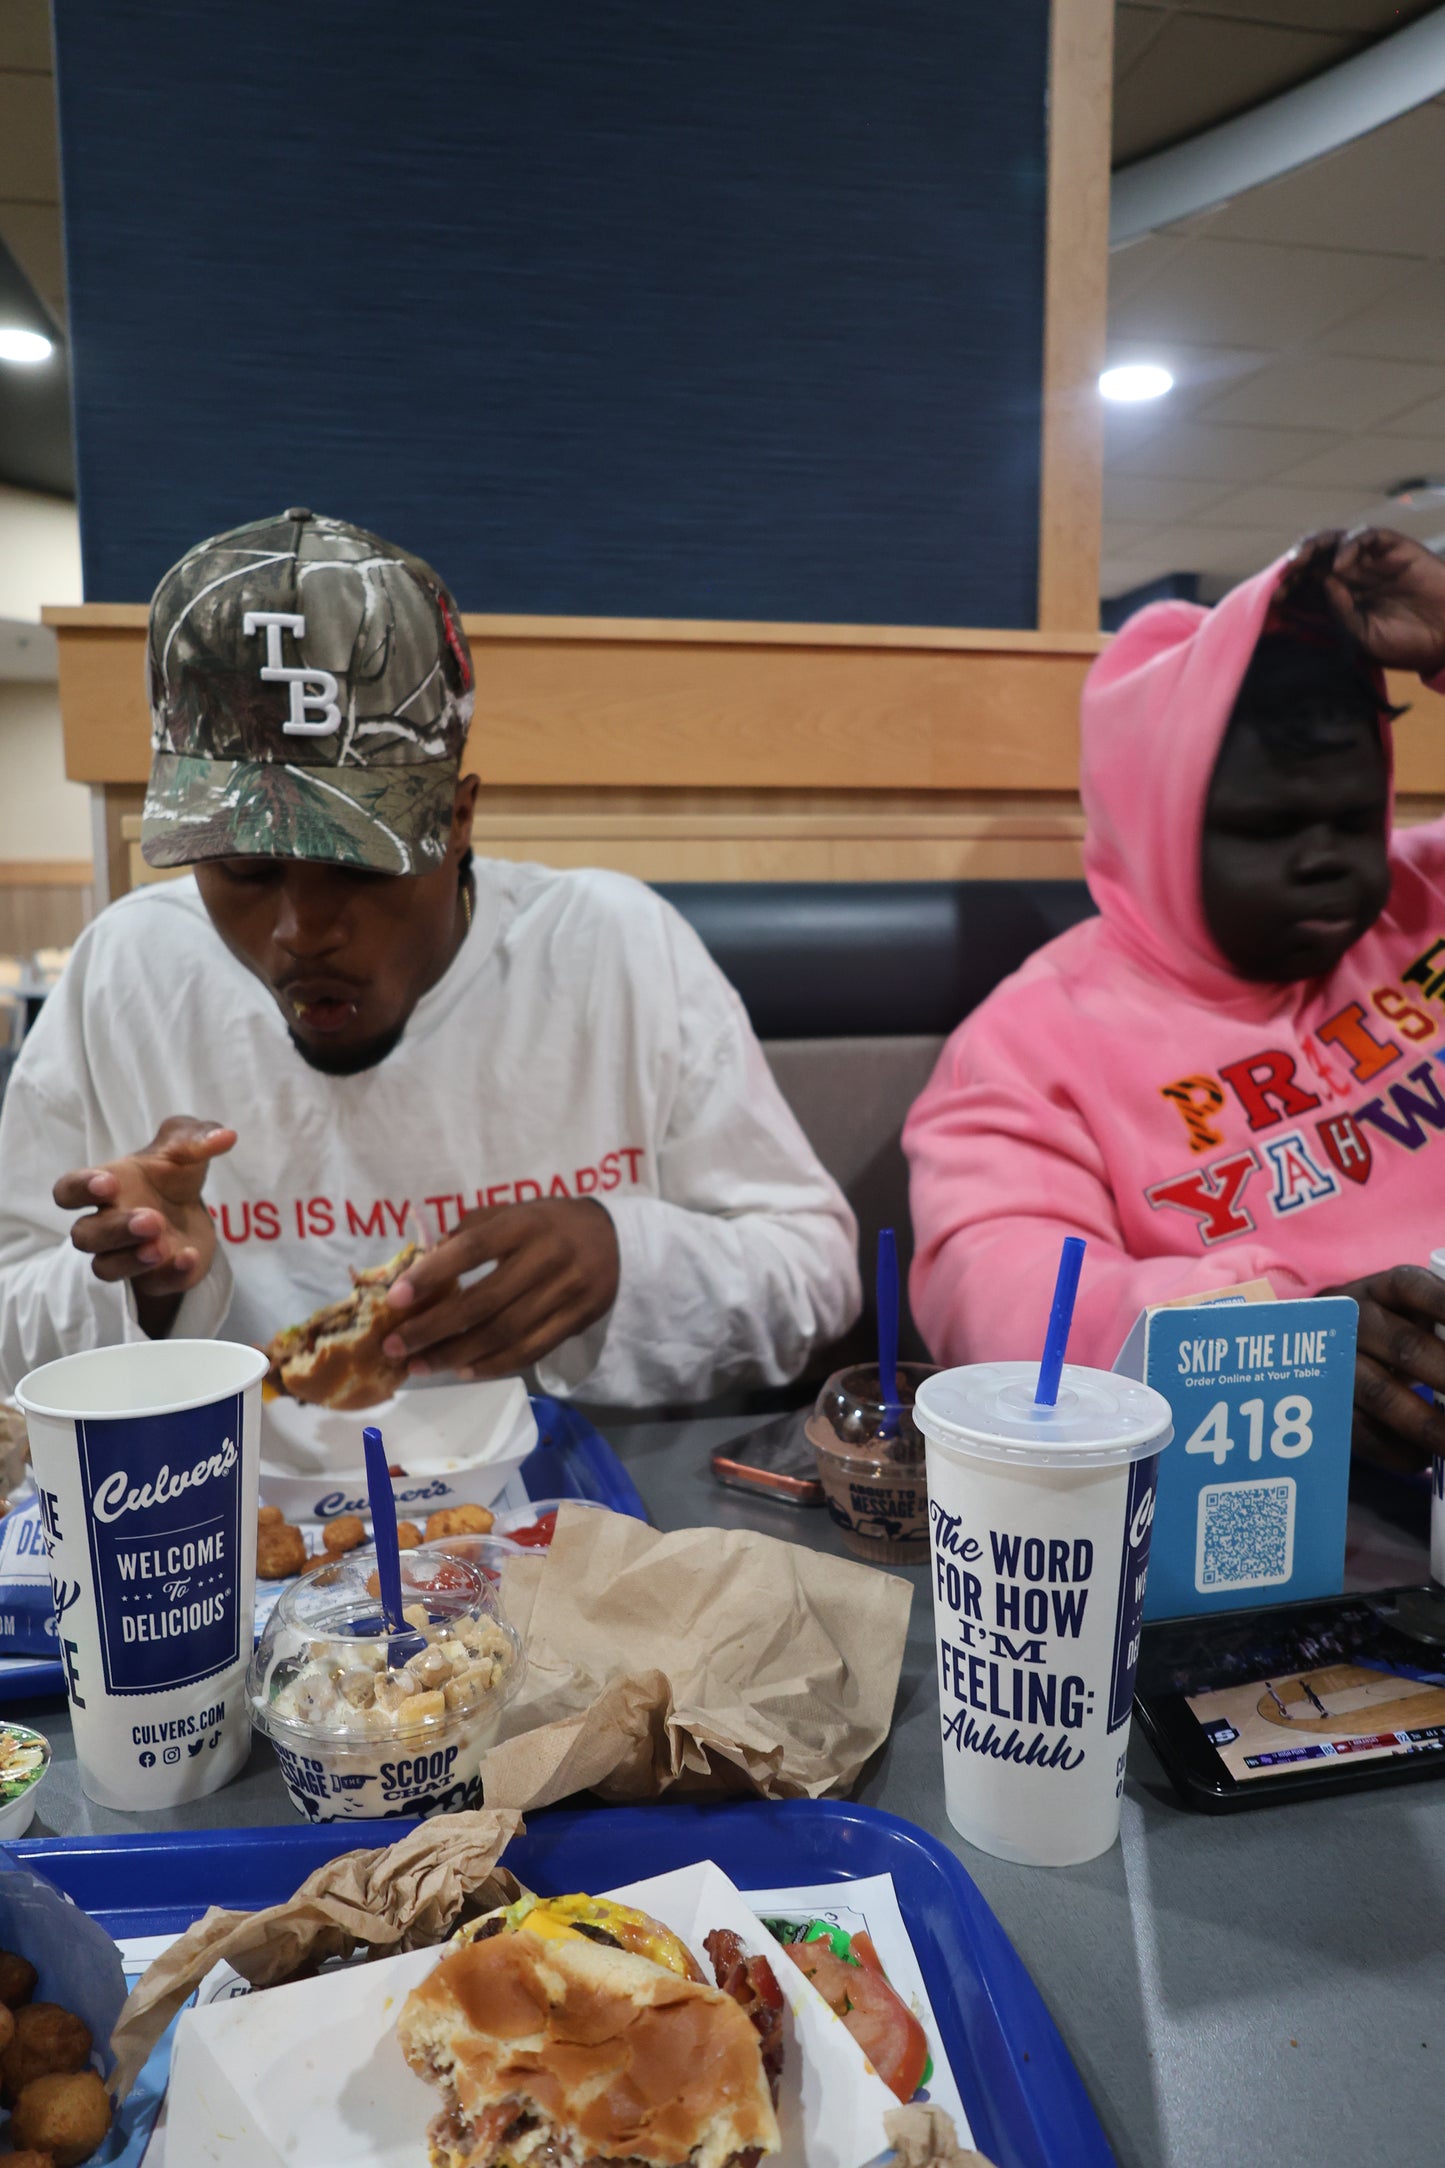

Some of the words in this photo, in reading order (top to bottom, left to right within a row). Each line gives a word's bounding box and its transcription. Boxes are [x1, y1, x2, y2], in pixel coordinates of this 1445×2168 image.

[243, 612, 342, 737] TB
[209, 1201, 281, 1244] US
[295, 1196, 336, 1239] IS
[345, 1198, 411, 1238] MY
[1178, 1338, 1229, 1374] SKIP
[1235, 1334, 1275, 1370] THE
[1281, 1330, 1328, 1367] LINE
[1185, 1376, 1216, 1388] Order
[1218, 1373, 1251, 1385] Online
[1254, 1371, 1265, 1382] at
[1267, 1370, 1291, 1381] Your
[1293, 1367, 1320, 1378] Table
[1185, 1395, 1313, 1465] 418
[93, 1437, 238, 1523] Culver's
[897, 1490, 915, 1499] TO
[851, 1493, 915, 1518] MESSAGE
[116, 1531, 224, 1581] WELCOME
[930, 1499, 984, 1563] The
[989, 1530, 1094, 1583] WORD
[162, 1577, 191, 1602] To
[936, 1551, 983, 1621] FOR
[996, 1582, 1089, 1638] HOW
[122, 1592, 225, 1643] DELICIOUS
[959, 1618, 1047, 1664] I'M
[941, 1638, 1095, 1729] FEELING:
[132, 1701, 225, 1745] CULVERS.COM
[300, 1756, 323, 1773] TO
[344, 1777, 361, 1785] THE
[380, 1745, 458, 1791] SCOOP
[382, 1773, 456, 1801] CHAT
